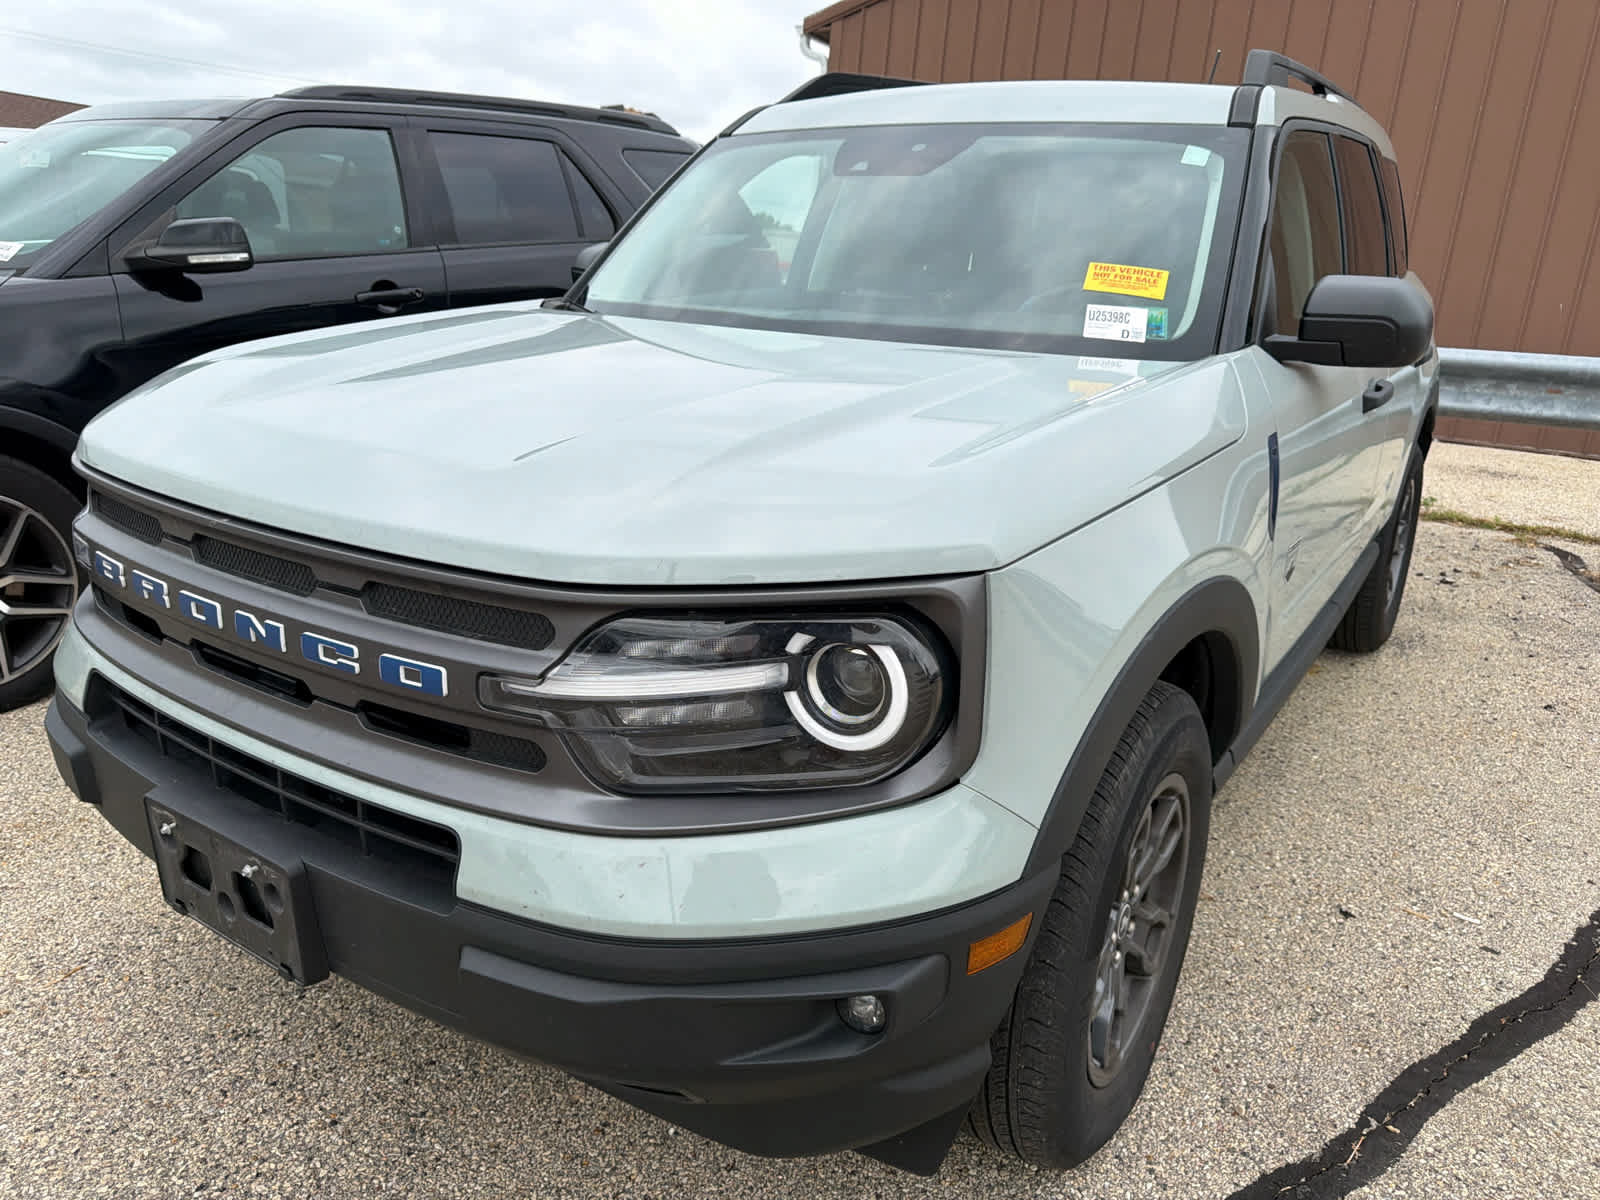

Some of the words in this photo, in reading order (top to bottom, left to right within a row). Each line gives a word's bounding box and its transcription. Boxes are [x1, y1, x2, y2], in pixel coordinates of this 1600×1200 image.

[1092, 271, 1111, 279] NOT
[1113, 273, 1132, 281] FOR
[1135, 276, 1159, 285] SALE
[1093, 264, 1116, 273] THIS
[1119, 267, 1163, 279] VEHICLE
[1088, 309, 1131, 325] U25398C
[1121, 329, 1130, 339] D
[95, 549, 449, 697] BRONCO
